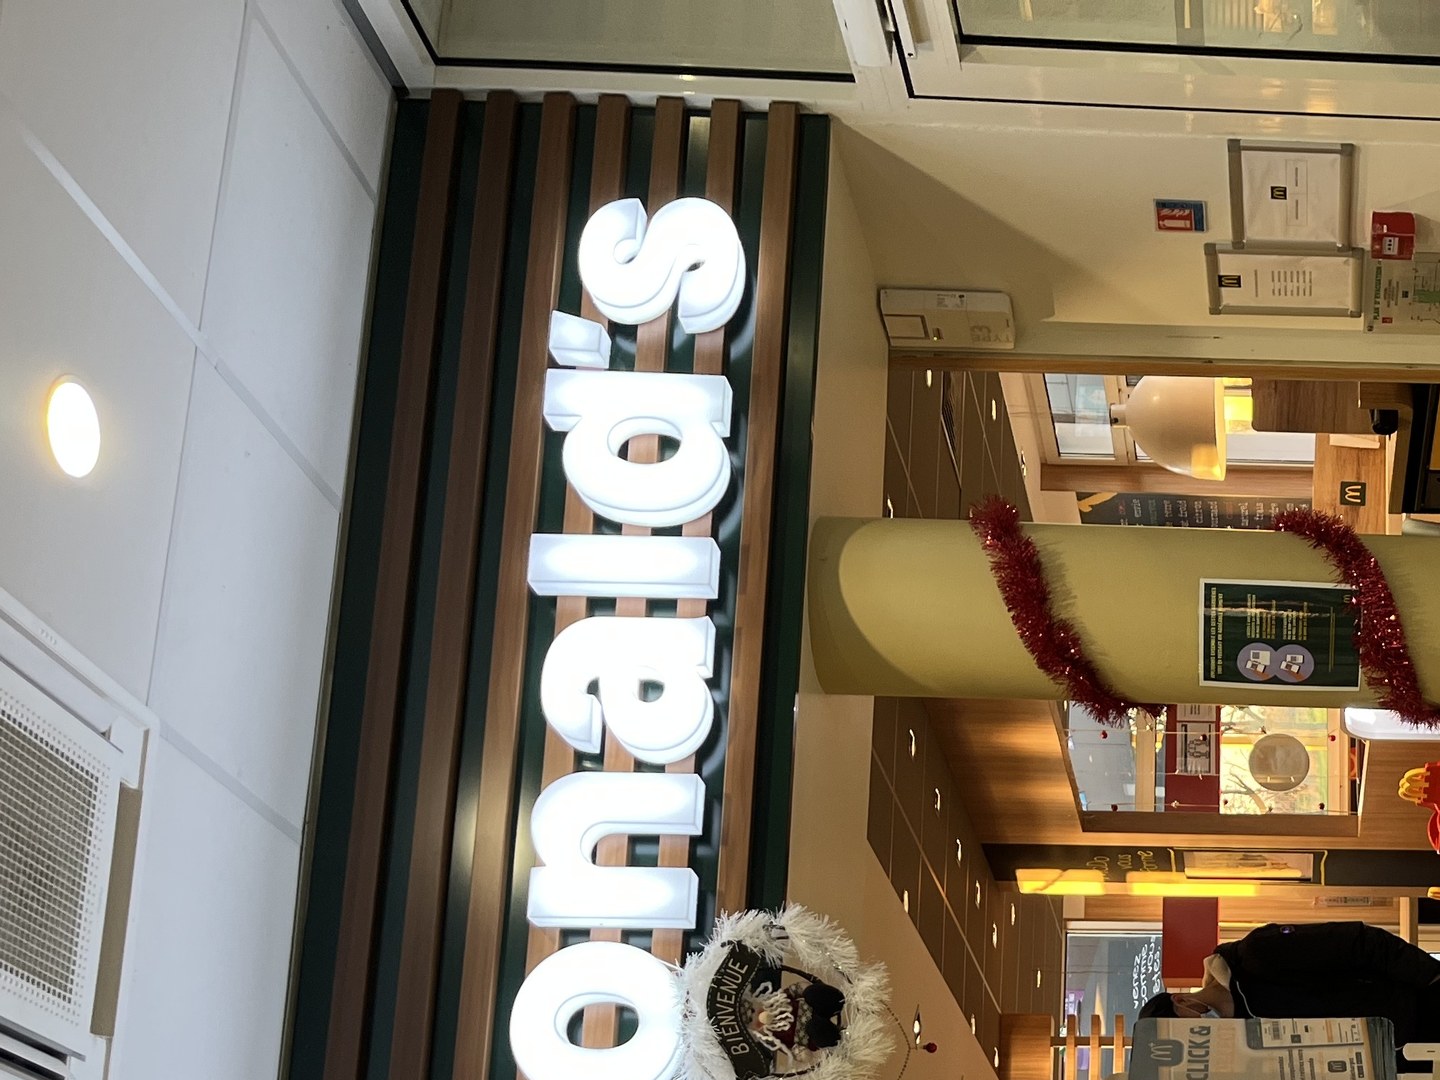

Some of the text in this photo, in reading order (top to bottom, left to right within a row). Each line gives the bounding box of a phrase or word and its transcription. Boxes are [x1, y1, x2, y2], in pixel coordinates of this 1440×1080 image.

[716, 958, 749, 1055] BIENVENUE
[1132, 953, 1141, 1009] venez
[1190, 1026, 1210, 1036] &
